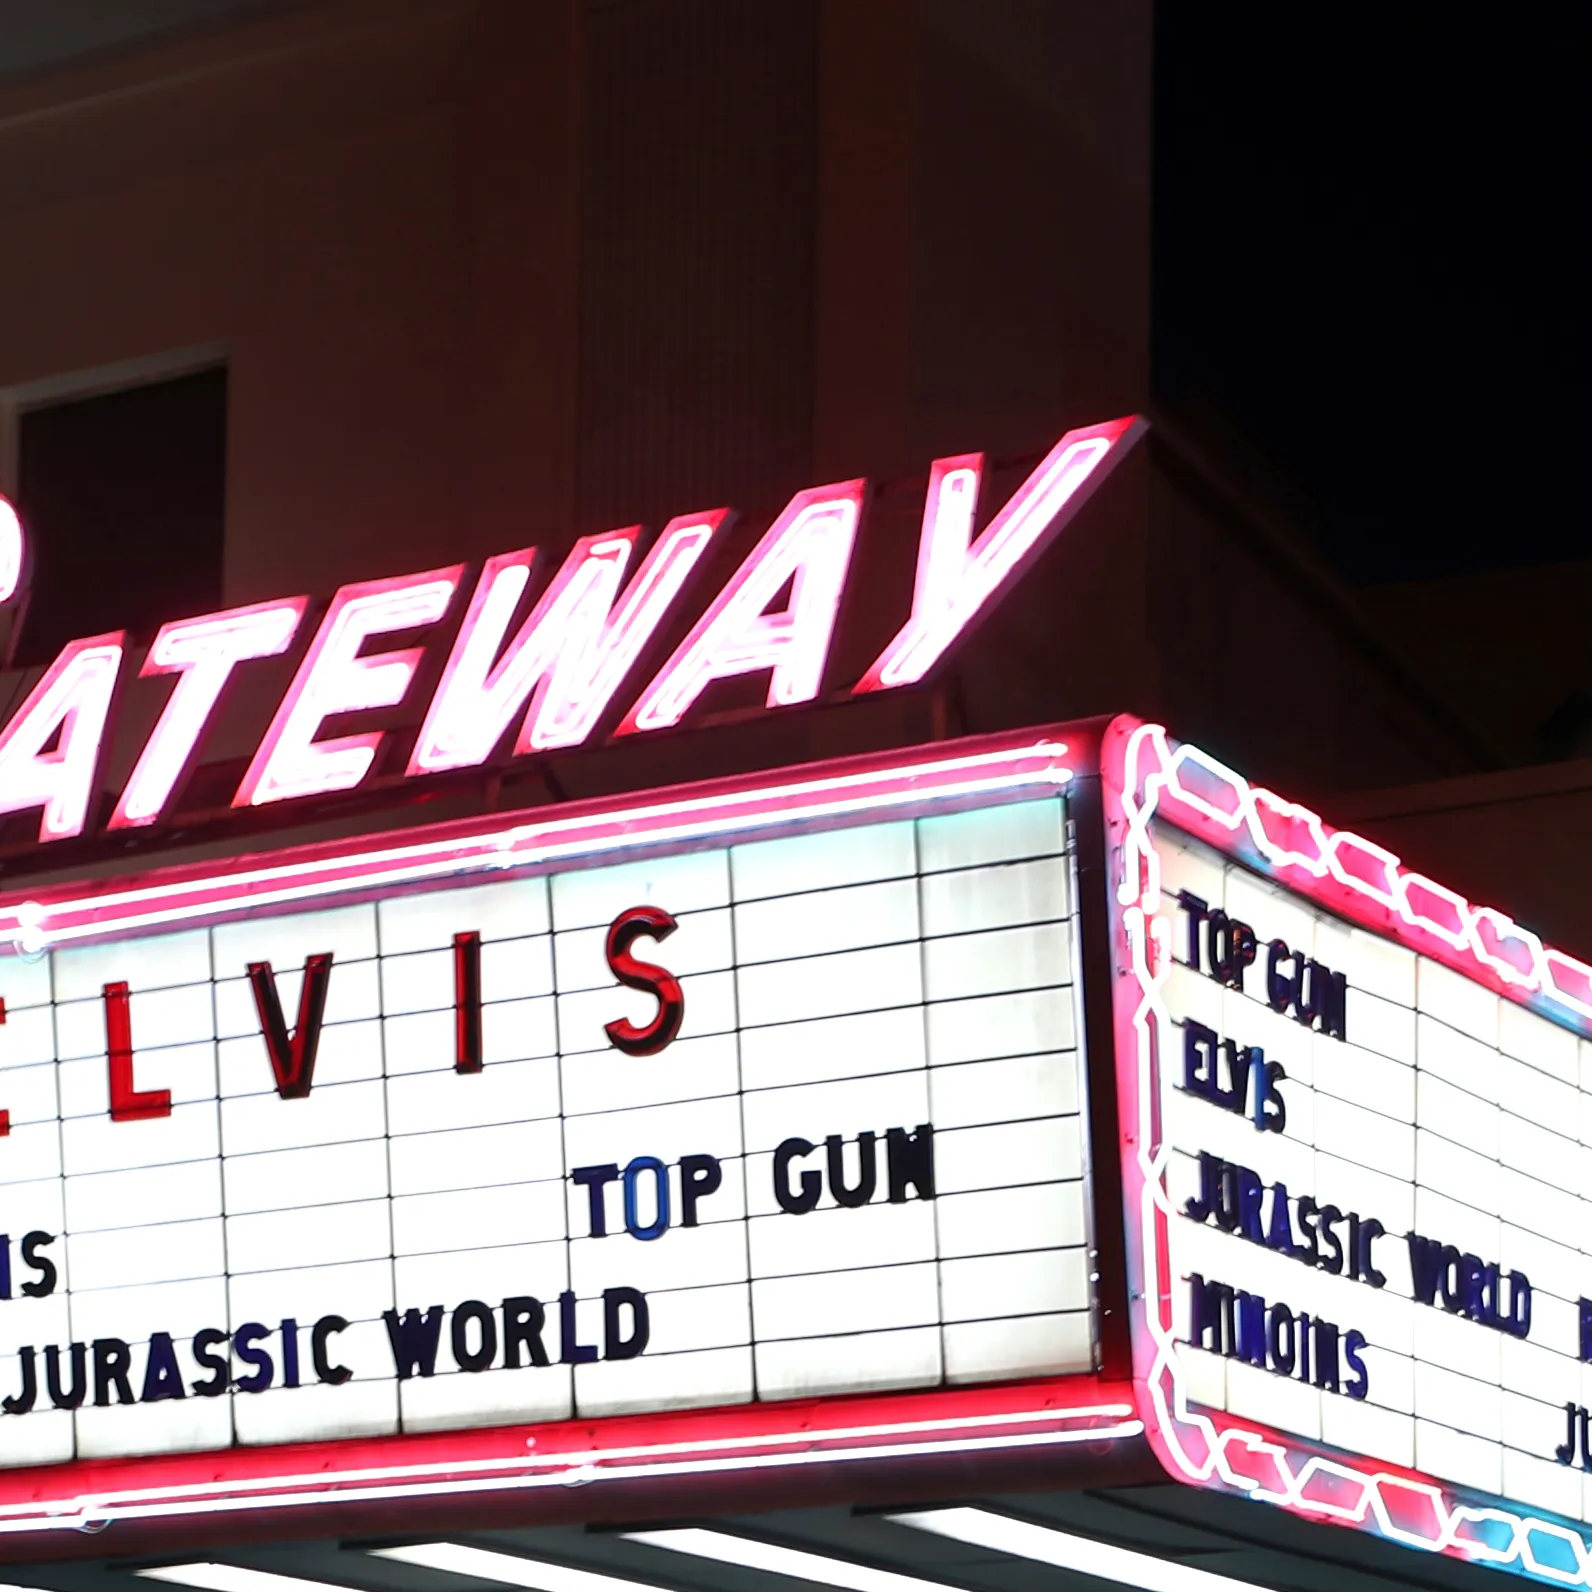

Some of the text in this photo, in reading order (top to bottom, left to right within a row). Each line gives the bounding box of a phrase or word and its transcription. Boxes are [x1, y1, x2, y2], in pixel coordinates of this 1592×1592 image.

[1177, 888, 1347, 1042] TOP GUN
[1184, 1017, 1286, 1133] ELVIS
[572, 1123, 934, 1241] TOP GUN
[1183, 1150, 1531, 1340] JURASSIC WORLD
[2, 1287, 650, 1415] JURASSIC WORLD
